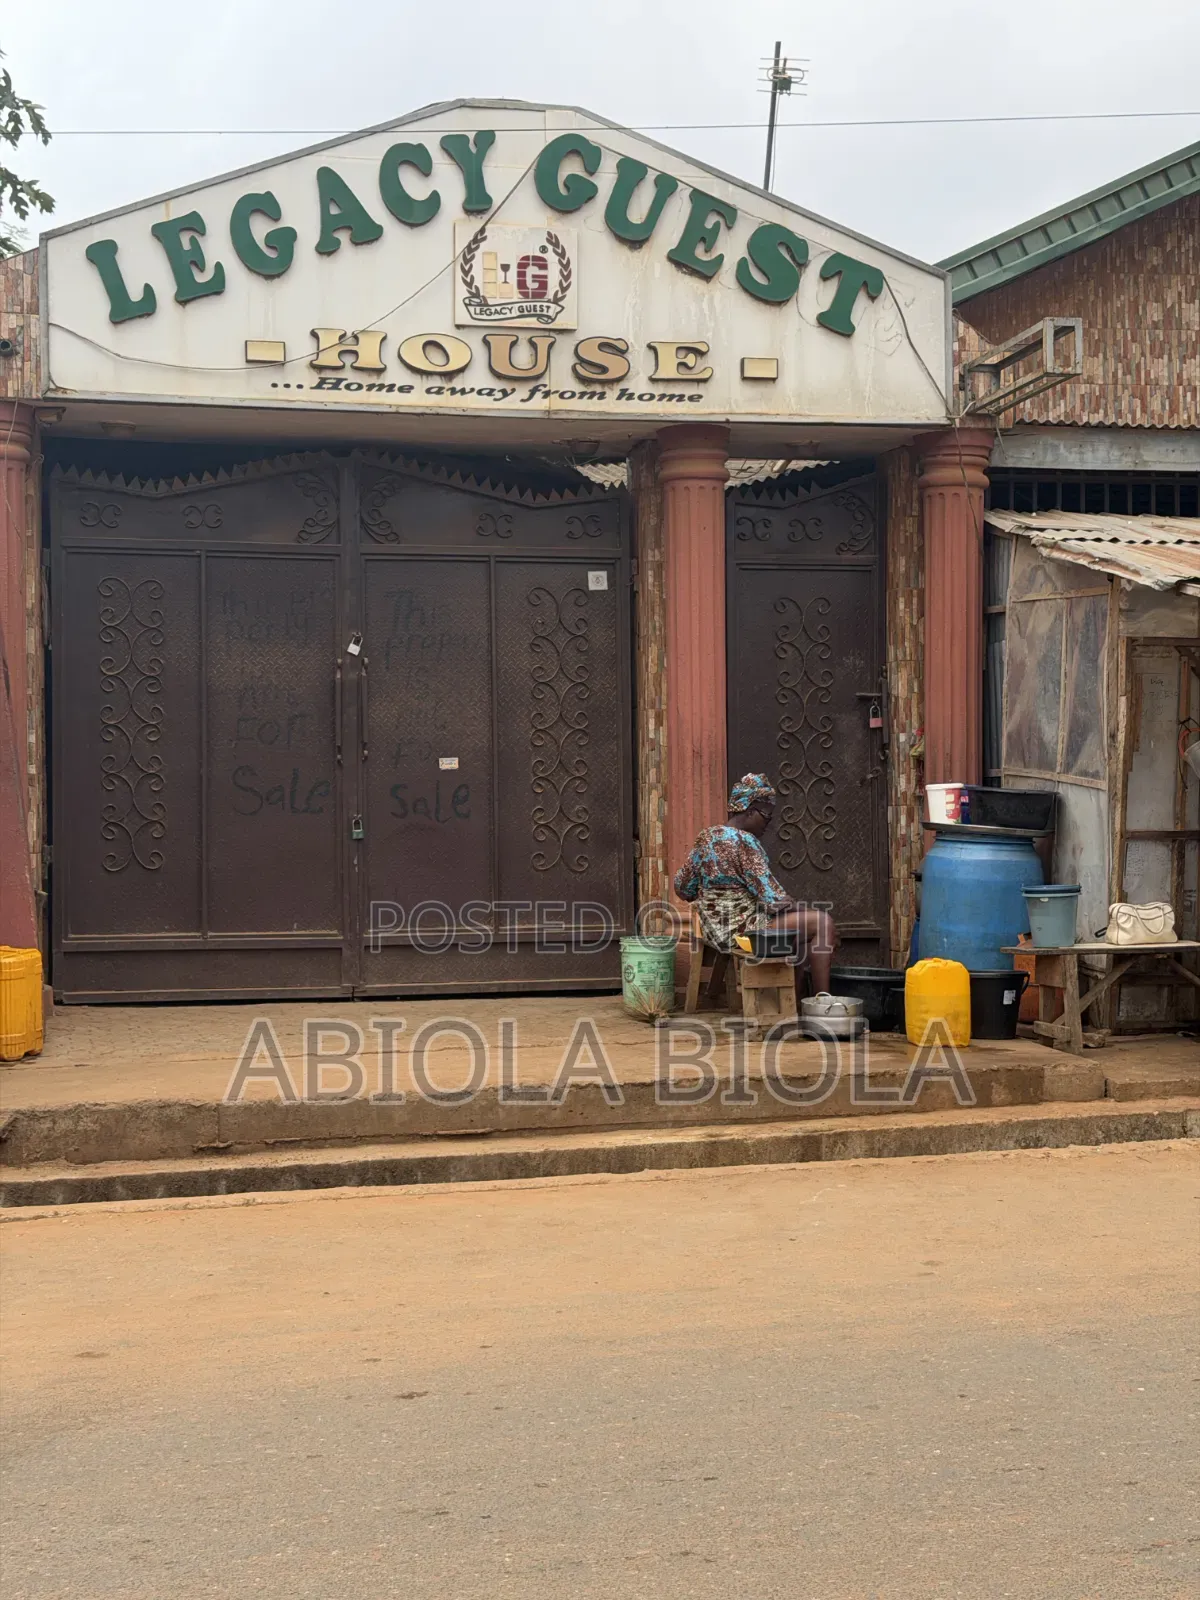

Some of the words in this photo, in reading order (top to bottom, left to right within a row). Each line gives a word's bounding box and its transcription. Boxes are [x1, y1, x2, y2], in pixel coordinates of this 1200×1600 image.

[86, 130, 496, 324] LEGACY
[534, 133, 884, 337] GUEST
[473, 306, 514, 316] LEGACY
[517, 304, 552, 314] GUEST
[310, 328, 714, 383] HOUSE
[425, 384, 517, 402] away
[520, 383, 607, 403] from
[615, 388, 704, 403] home
[231, 764, 331, 816] Sale
[389, 780, 471, 823] Sale
